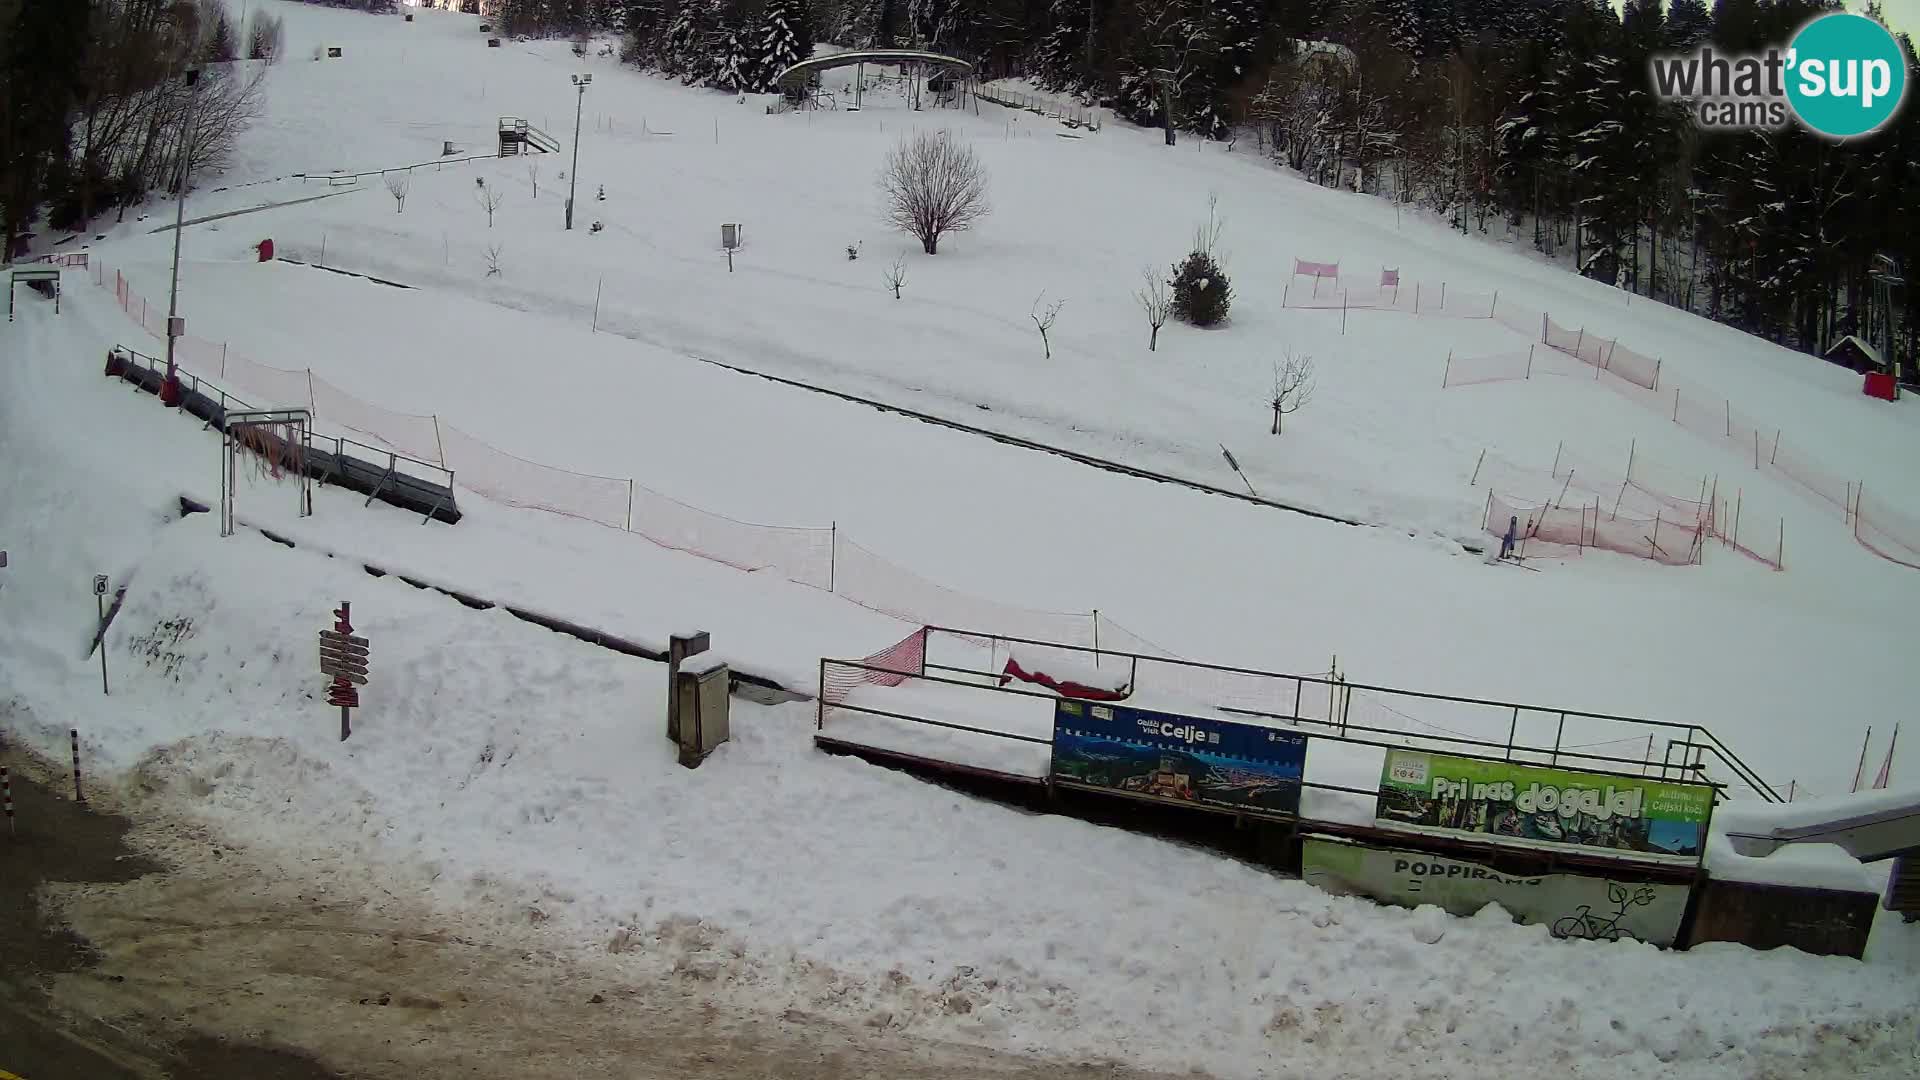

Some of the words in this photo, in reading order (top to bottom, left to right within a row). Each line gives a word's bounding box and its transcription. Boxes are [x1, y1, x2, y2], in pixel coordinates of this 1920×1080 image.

[1160, 722, 1206, 744] Celje
[1430, 776, 1469, 801] Pri
[1472, 780, 1515, 802] nas
